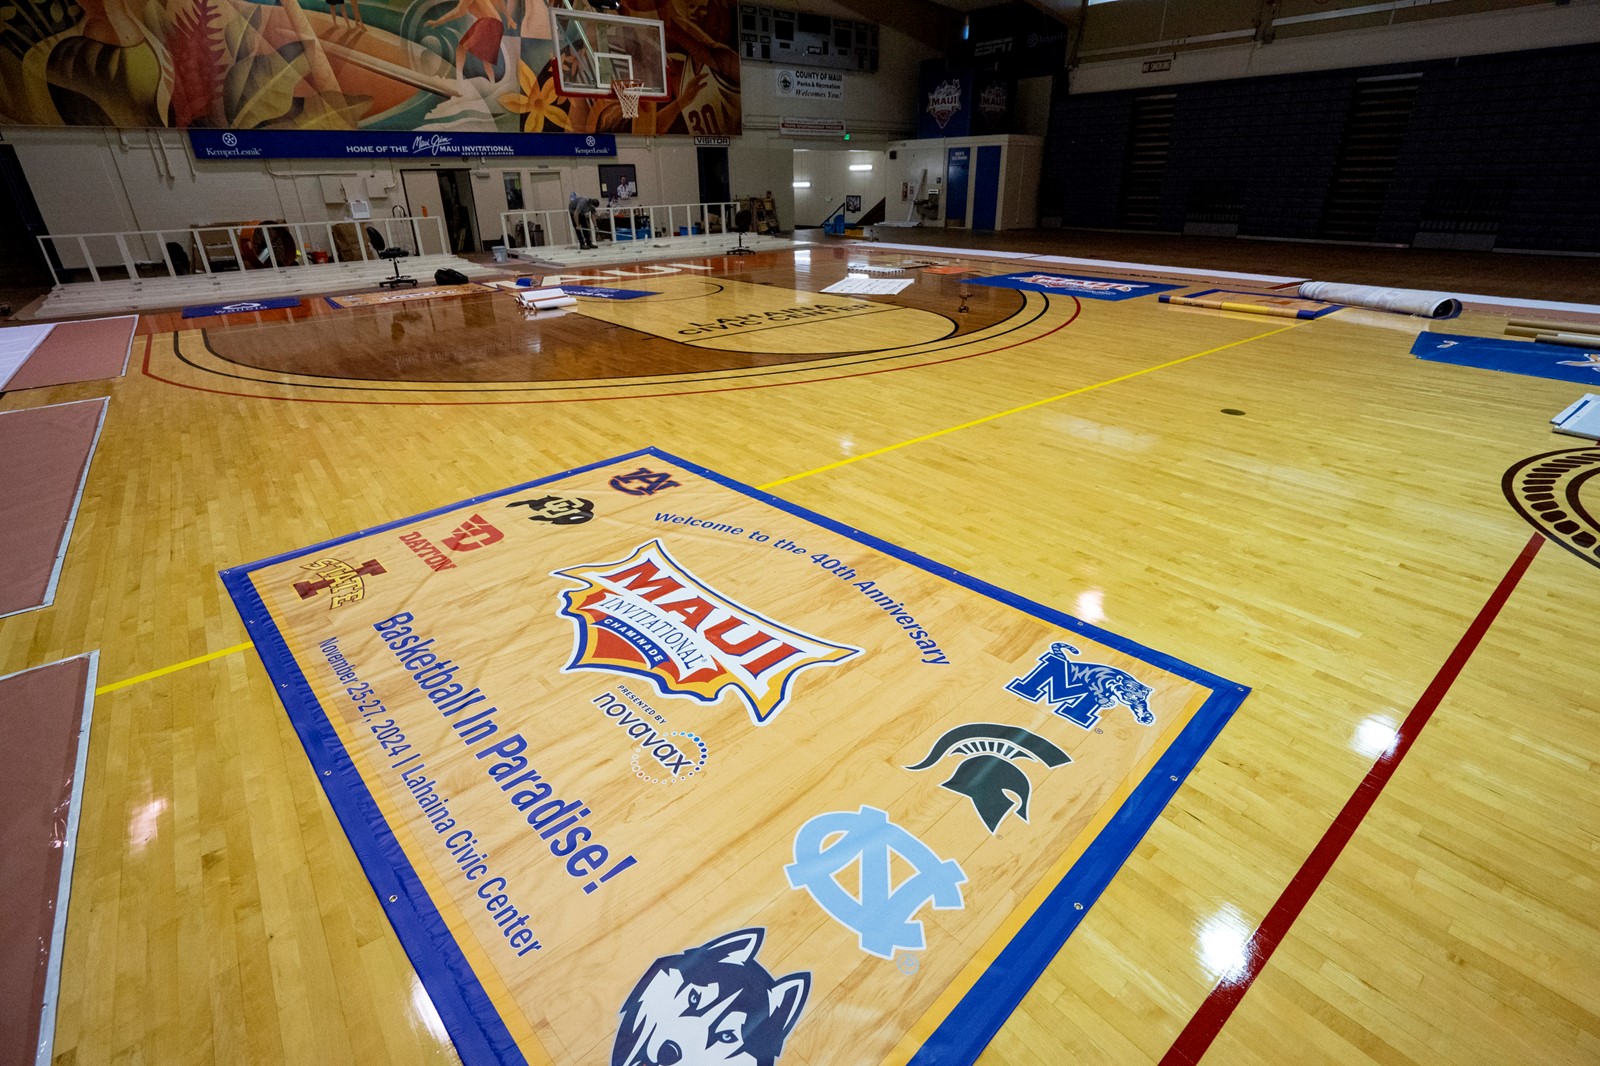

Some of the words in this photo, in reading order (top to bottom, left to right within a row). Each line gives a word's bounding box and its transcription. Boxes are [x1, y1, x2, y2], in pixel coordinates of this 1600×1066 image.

[974, 37, 1014, 56] ESPN
[796, 70, 819, 79] COUNTY
[828, 91, 842, 99] You!
[688, 104, 721, 135] 30
[932, 96, 957, 106] MAUI
[678, 318, 763, 336] CIVIC
[768, 303, 877, 322] CENTER
[690, 303, 837, 327] LAHAINA
[398, 530, 458, 572] DAYTON
[299, 557, 366, 611] STATE
[654, 511, 744, 536] Welcome
[748, 530, 771, 543] to
[773, 536, 807, 556] the
[810, 552, 857, 581] 40th
[852, 580, 951, 666] Anniversary
[598, 557, 806, 681] MAUI
[598, 596, 703, 671] INVITATIONAL
[603, 617, 665, 663] CHAMINADE
[617, 684, 655, 716] PRESENTED
[654, 714, 668, 725] BY
[372, 611, 487, 718] Basketball
[452, 706, 489, 746] In
[475, 733, 638, 895] Paradise!
[592, 692, 693, 776] novavax
[318, 636, 358, 685] November
[346, 682, 387, 724] 25-27,
[370, 719, 412, 757] 2024
[400, 763, 456, 835] Lahaina
[445, 829, 488, 881] Civic
[477, 876, 543, 958] Center
